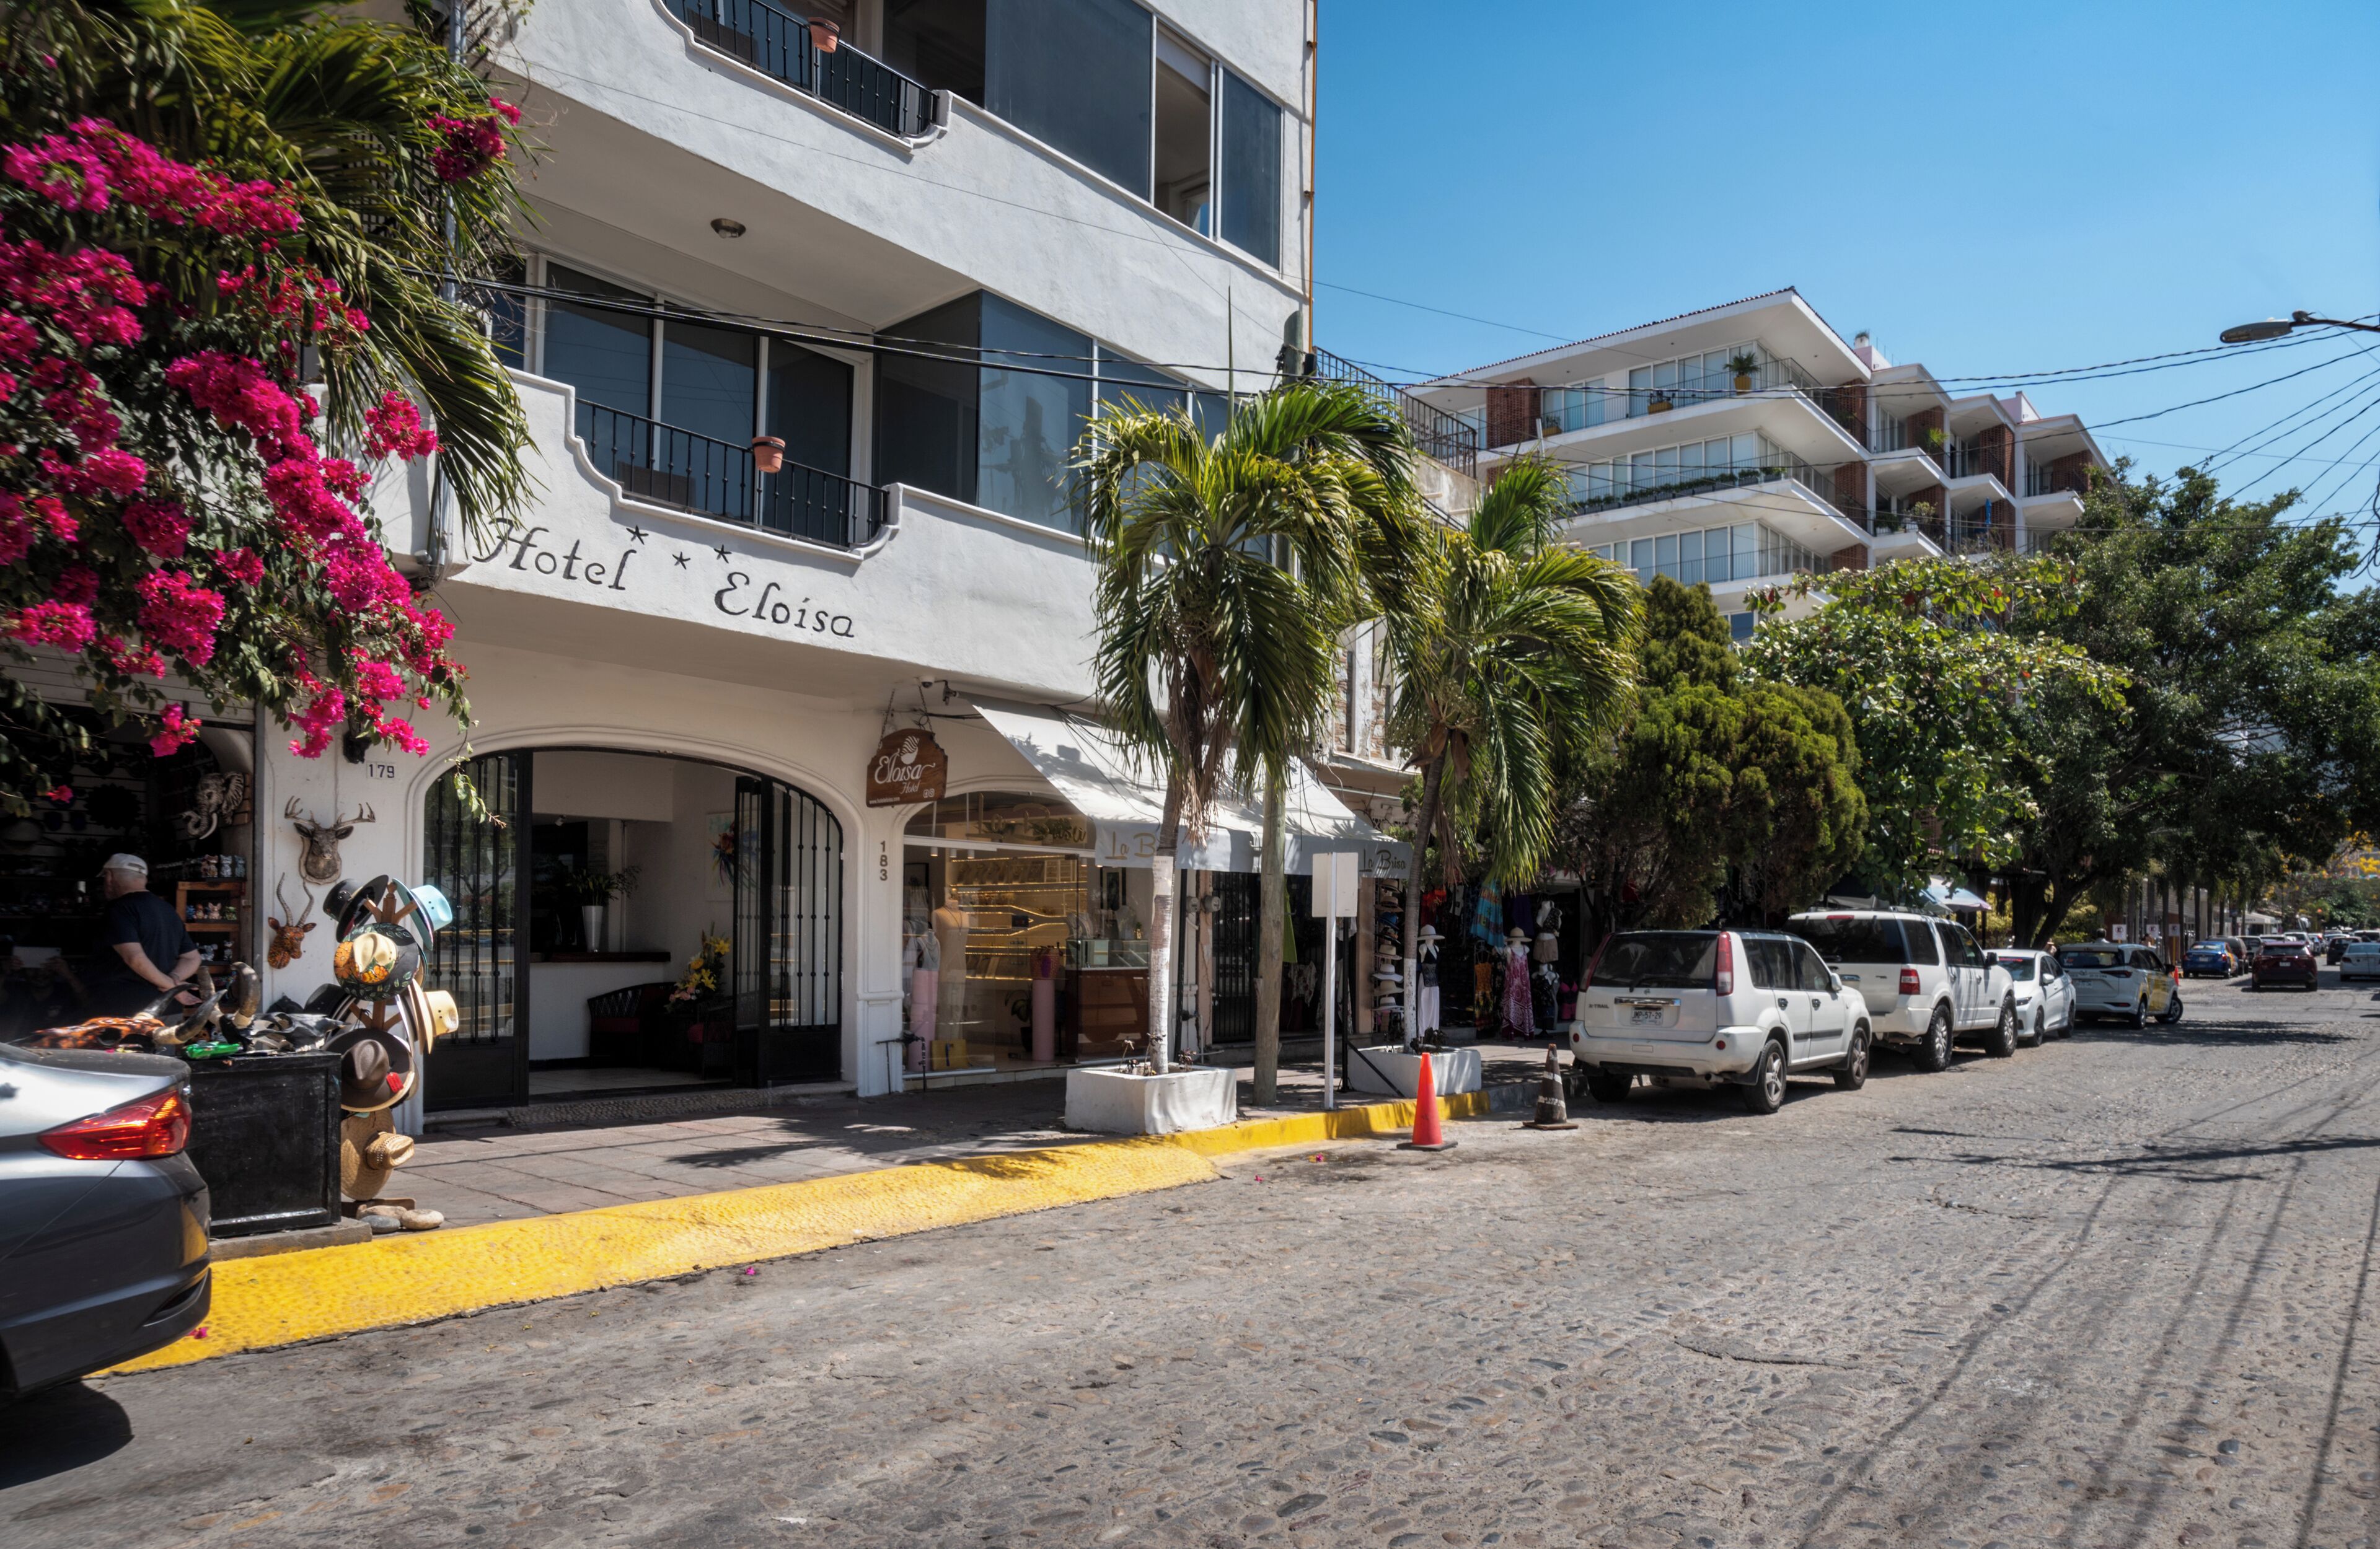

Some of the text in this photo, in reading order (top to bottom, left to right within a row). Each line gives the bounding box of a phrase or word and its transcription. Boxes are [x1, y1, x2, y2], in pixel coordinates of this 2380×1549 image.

[472, 517, 854, 638] Hotel Eloísa
[369, 764, 394, 778] 179
[900, 779, 921, 794] Hotel
[966, 792, 1005, 839] La
[1104, 831, 1130, 860] La
[1359, 848, 1407, 872] La Brisa
[879, 840, 888, 881] 183
